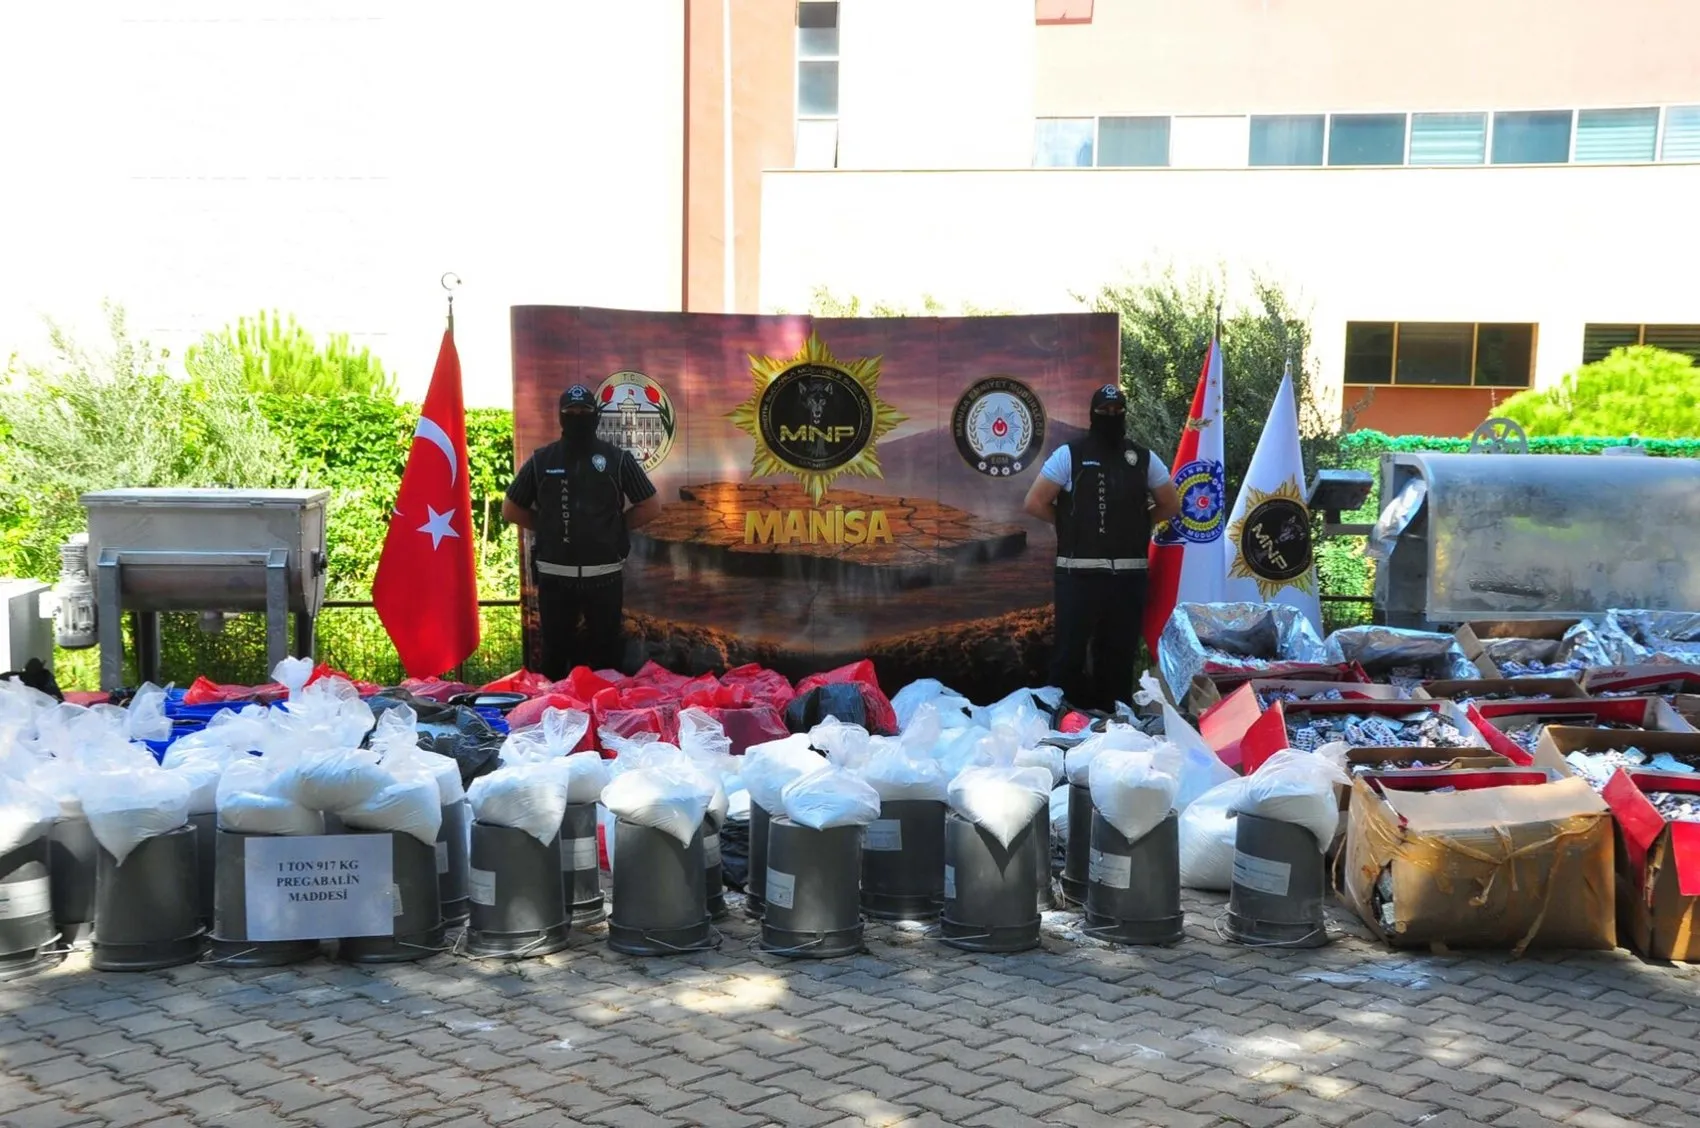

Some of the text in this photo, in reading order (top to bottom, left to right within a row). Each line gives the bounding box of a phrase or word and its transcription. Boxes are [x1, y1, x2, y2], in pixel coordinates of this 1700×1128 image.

[779, 424, 855, 443] MNP
[744, 504, 894, 545] MANİSA
[1251, 522, 1288, 570] MNP
[278, 859, 359, 872] 1 TON 917 KG
[276, 874, 360, 887] PREGABALİN
[288, 888, 348, 902] MADDESİ
